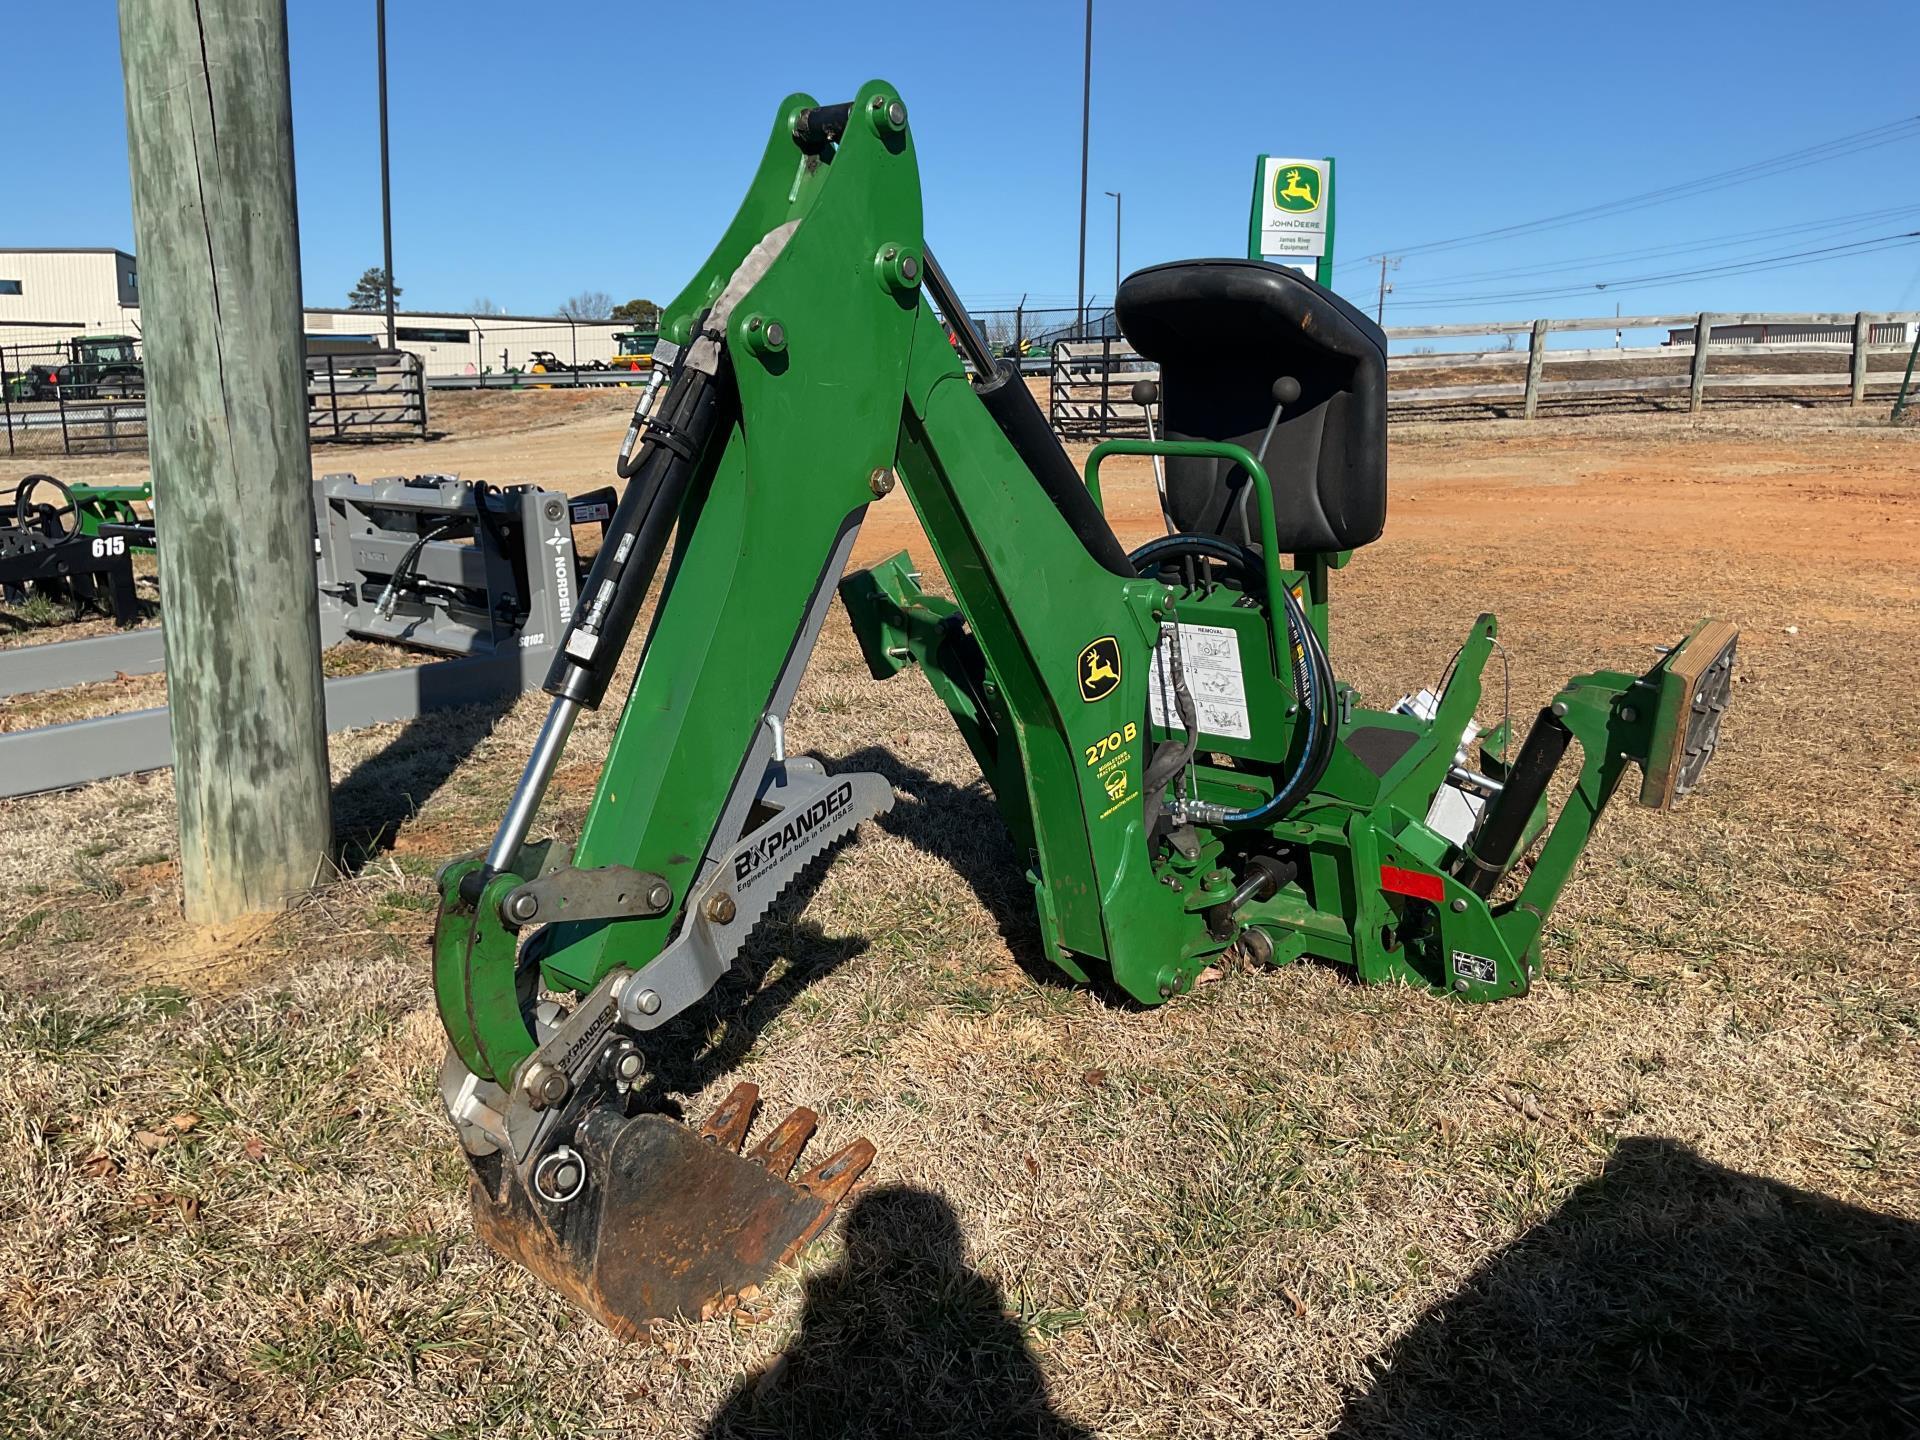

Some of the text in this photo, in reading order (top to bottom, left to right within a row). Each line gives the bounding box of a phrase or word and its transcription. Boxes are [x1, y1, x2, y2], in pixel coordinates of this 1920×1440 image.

[1270, 220, 1320, 229] JOHN DEERE
[92, 536, 125, 558] 615
[1197, 627, 1223, 635] REMOVAL
[518, 633, 545, 648] SQ102
[1085, 721, 1137, 767] 270 B
[737, 808, 848, 893] Engineered and built in the USA
